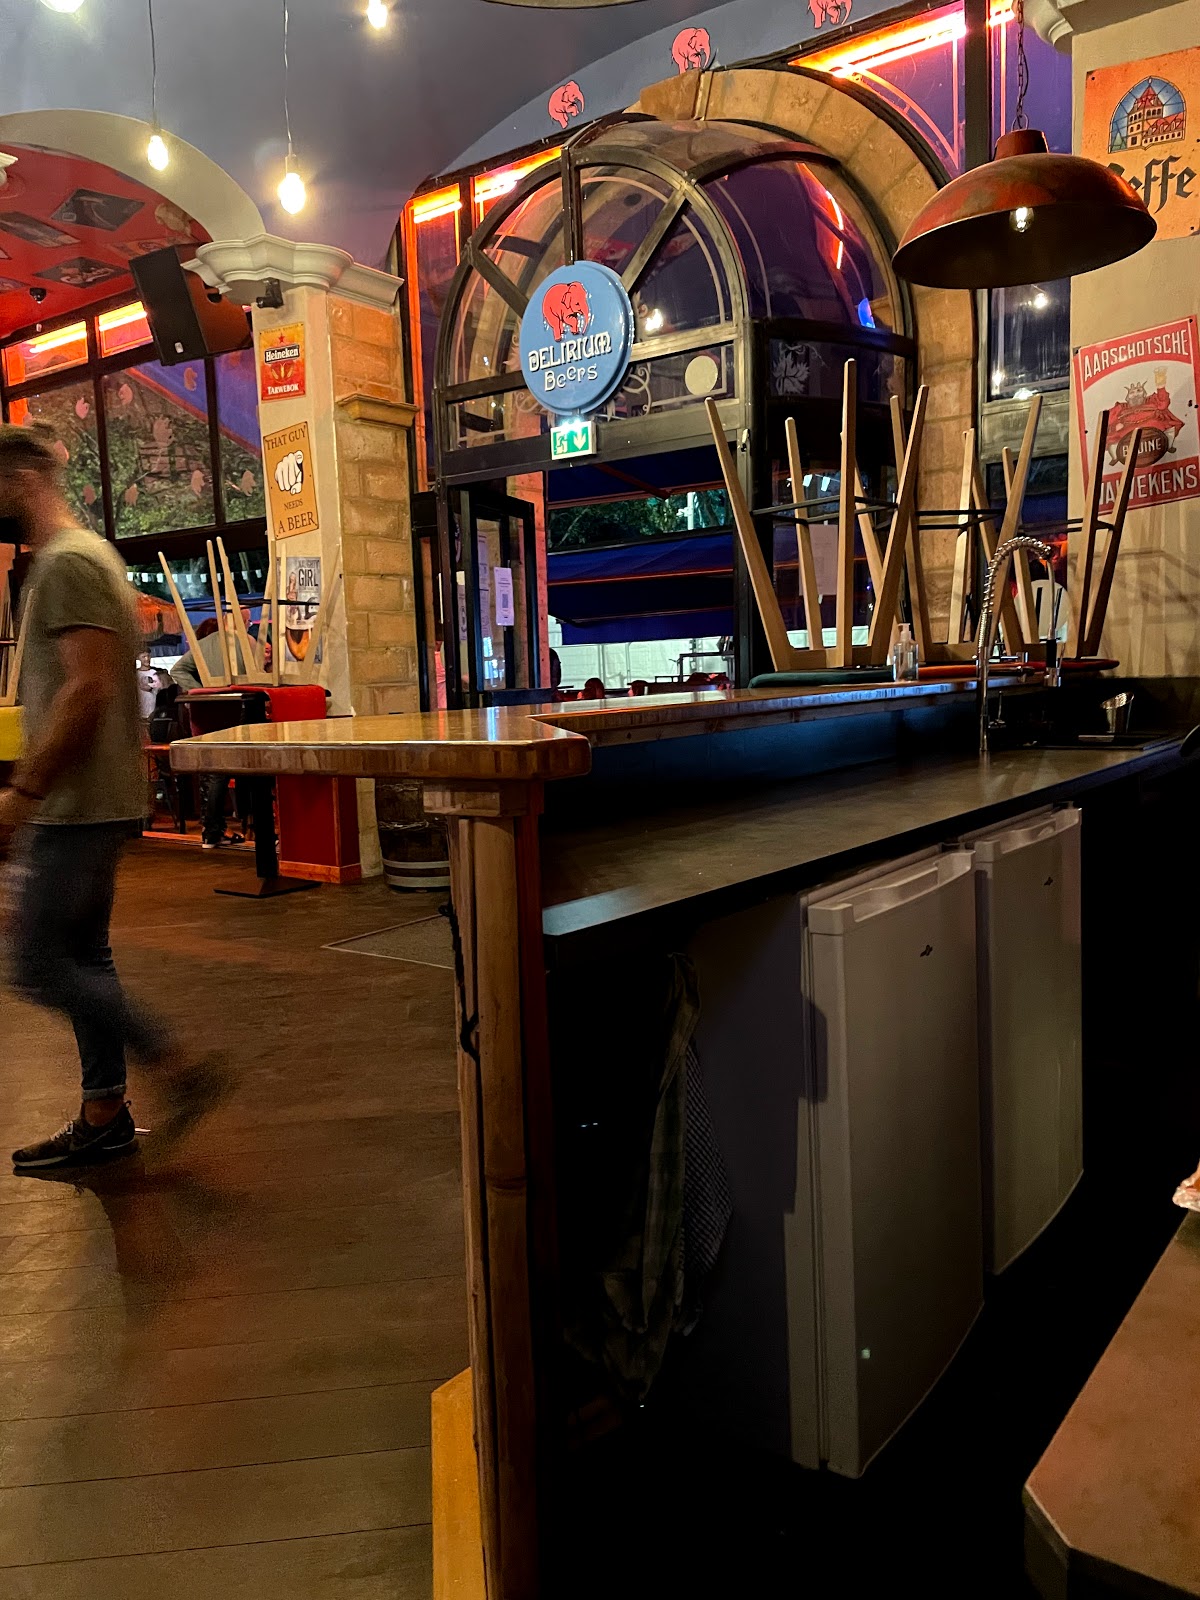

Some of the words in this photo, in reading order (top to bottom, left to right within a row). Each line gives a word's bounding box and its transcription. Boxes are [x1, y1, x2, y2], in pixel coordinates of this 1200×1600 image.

[1107, 155, 1197, 214] ffe
[266, 348, 299, 362] Heineken
[528, 331, 612, 372] DELIRIUM
[1084, 329, 1189, 382] AARSCHOTSCHE
[267, 383, 299, 395] TARWEBOK
[266, 434, 287, 450] THAT
[288, 425, 306, 443] GUY
[1122, 438, 1161, 457] BUINE
[1098, 464, 1198, 505] AEKENS
[284, 498, 303, 511] NEEDS
[278, 520, 286, 534] A
[287, 511, 315, 531] BEER
[298, 568, 319, 587] GIRL
